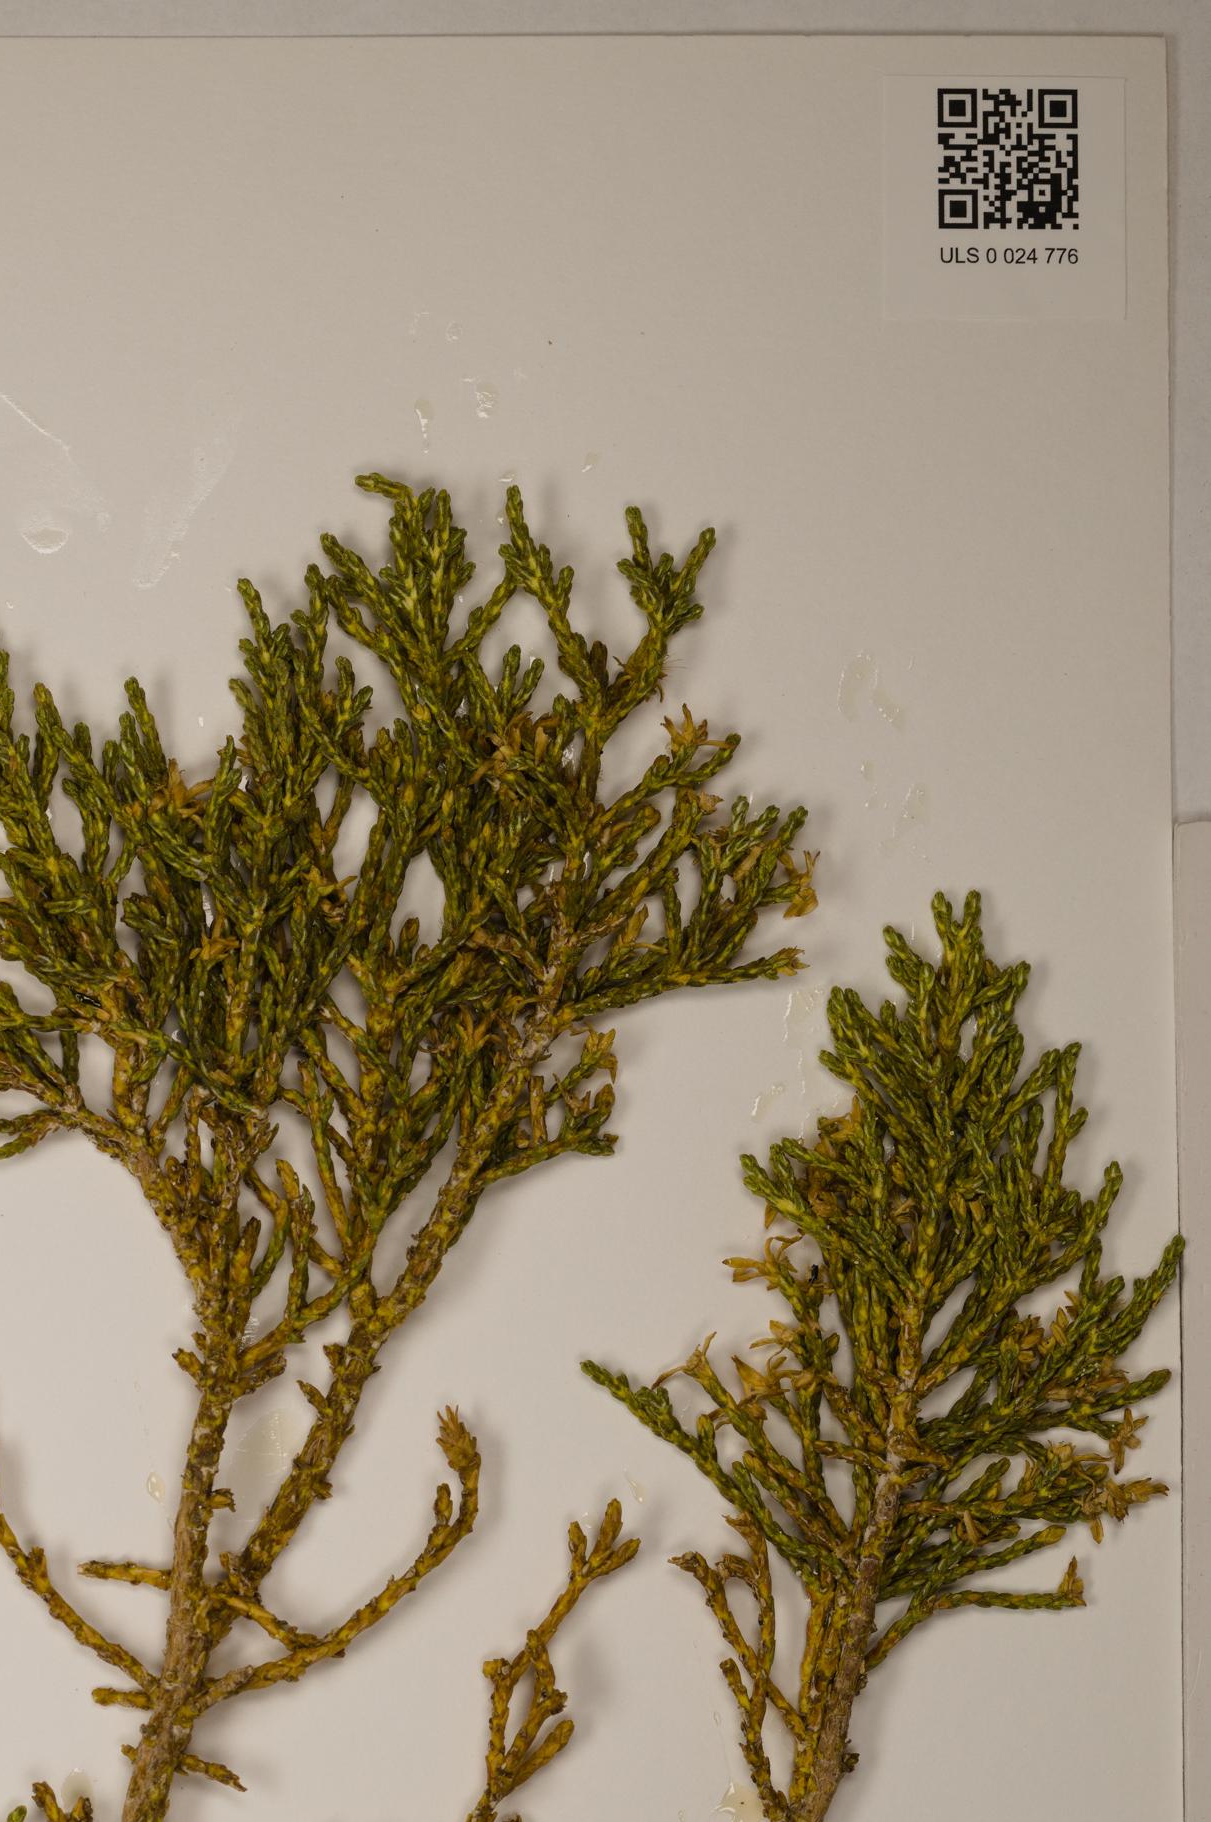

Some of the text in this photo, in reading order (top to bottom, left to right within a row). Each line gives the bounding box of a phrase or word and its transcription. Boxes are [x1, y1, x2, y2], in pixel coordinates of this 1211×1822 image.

[940, 247, 1079, 265] ULS 0 024 776
